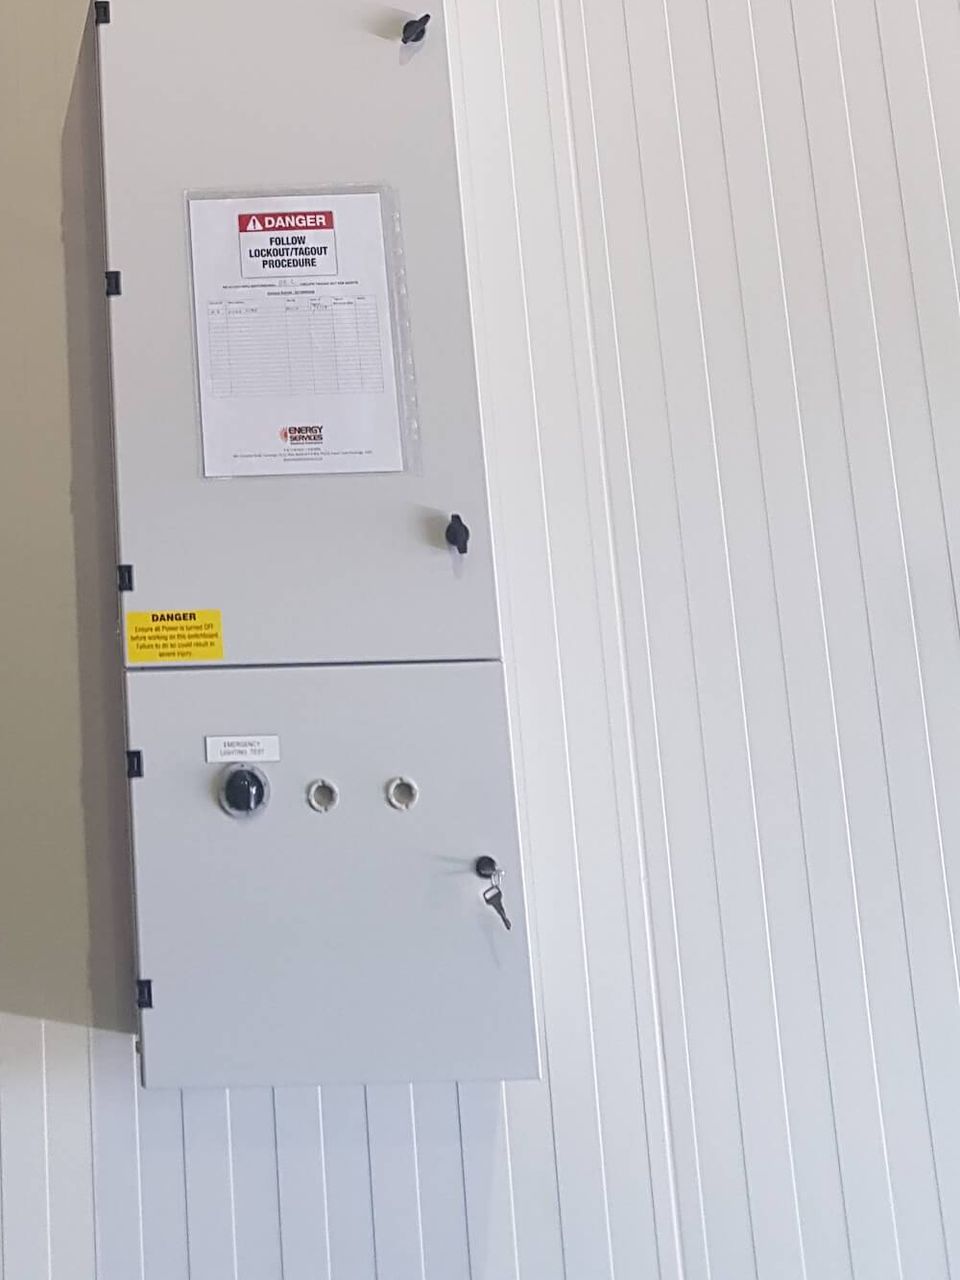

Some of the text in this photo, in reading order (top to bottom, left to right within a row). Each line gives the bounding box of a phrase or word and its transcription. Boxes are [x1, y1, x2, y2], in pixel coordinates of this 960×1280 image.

[264, 214, 327, 228] DANGER
[269, 235, 306, 246] FOLLOW
[249, 246, 328, 258] LOCKOUT/TAGOUT
[262, 258, 317, 269] PROCEDURE
[288, 425, 324, 435] ENERGY
[289, 434, 324, 442] SERVICES
[151, 612, 197, 623] DANGER
